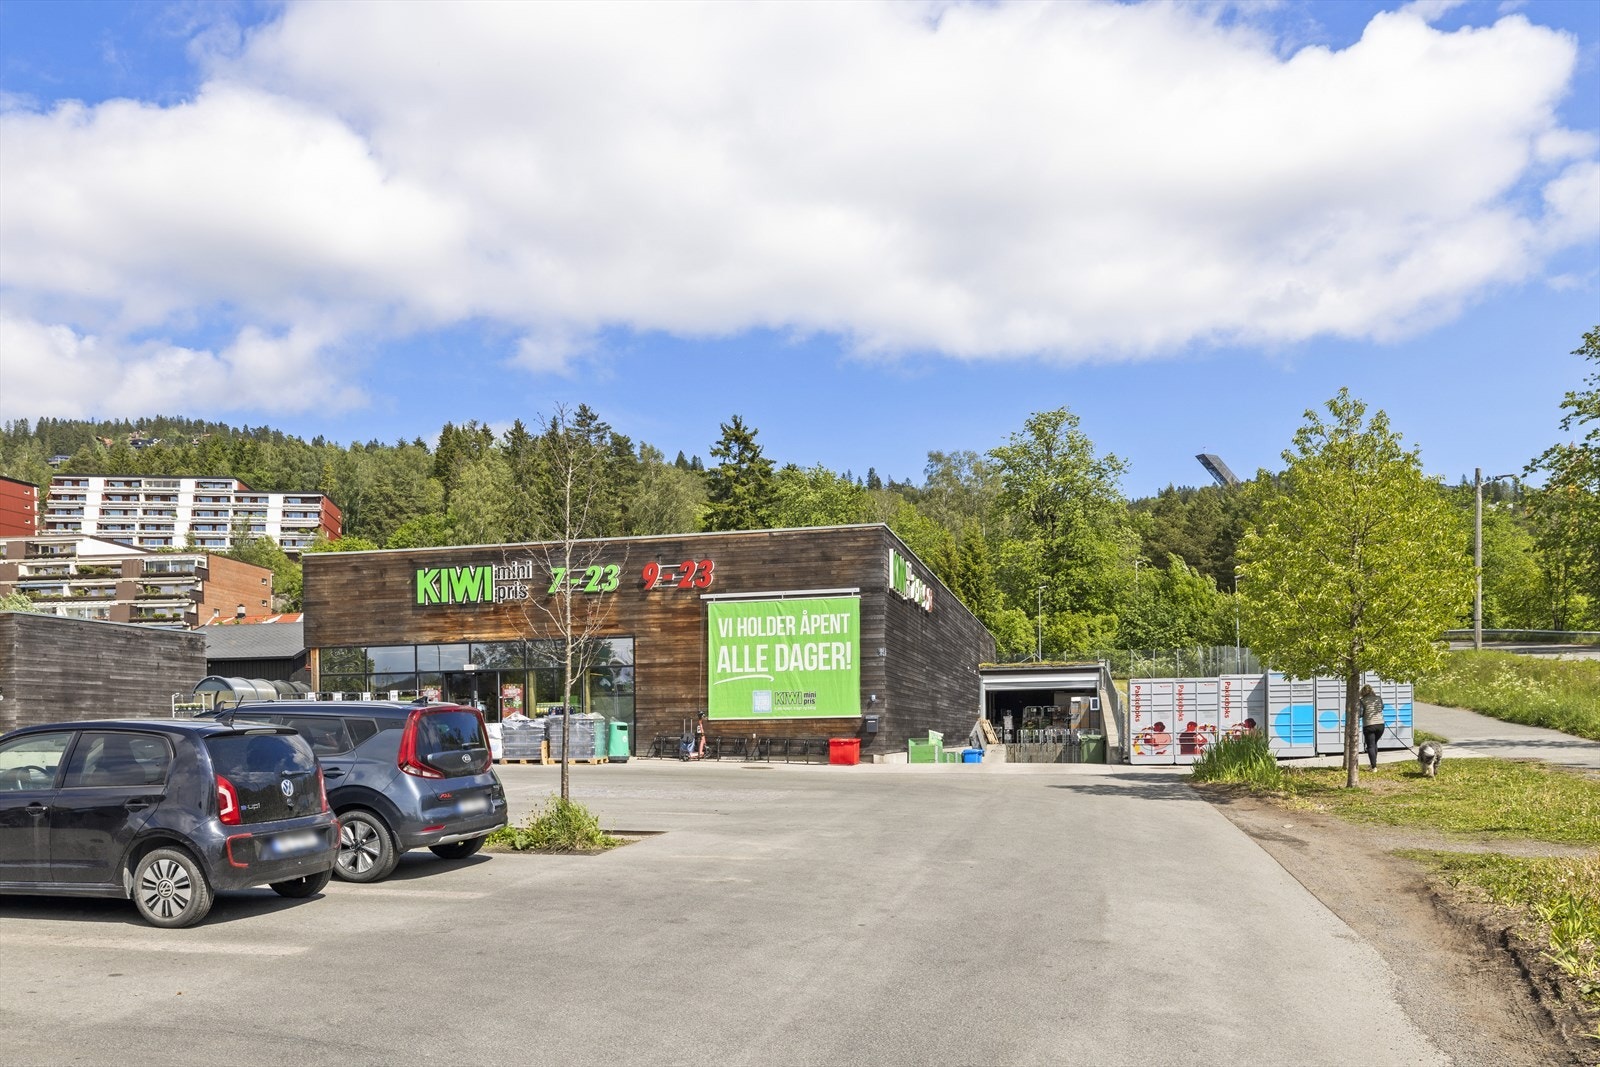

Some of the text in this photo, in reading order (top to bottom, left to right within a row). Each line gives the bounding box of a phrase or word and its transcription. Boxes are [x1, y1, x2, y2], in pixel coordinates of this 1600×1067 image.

[495, 560, 533, 580] mini
[416, 565, 496, 605] KIWI
[496, 580, 529, 604] pris
[718, 610, 851, 638] VI HOLDER ÅPENT
[717, 642, 852, 673] ALLE DAGER!
[774, 691, 802, 705] KIWI
